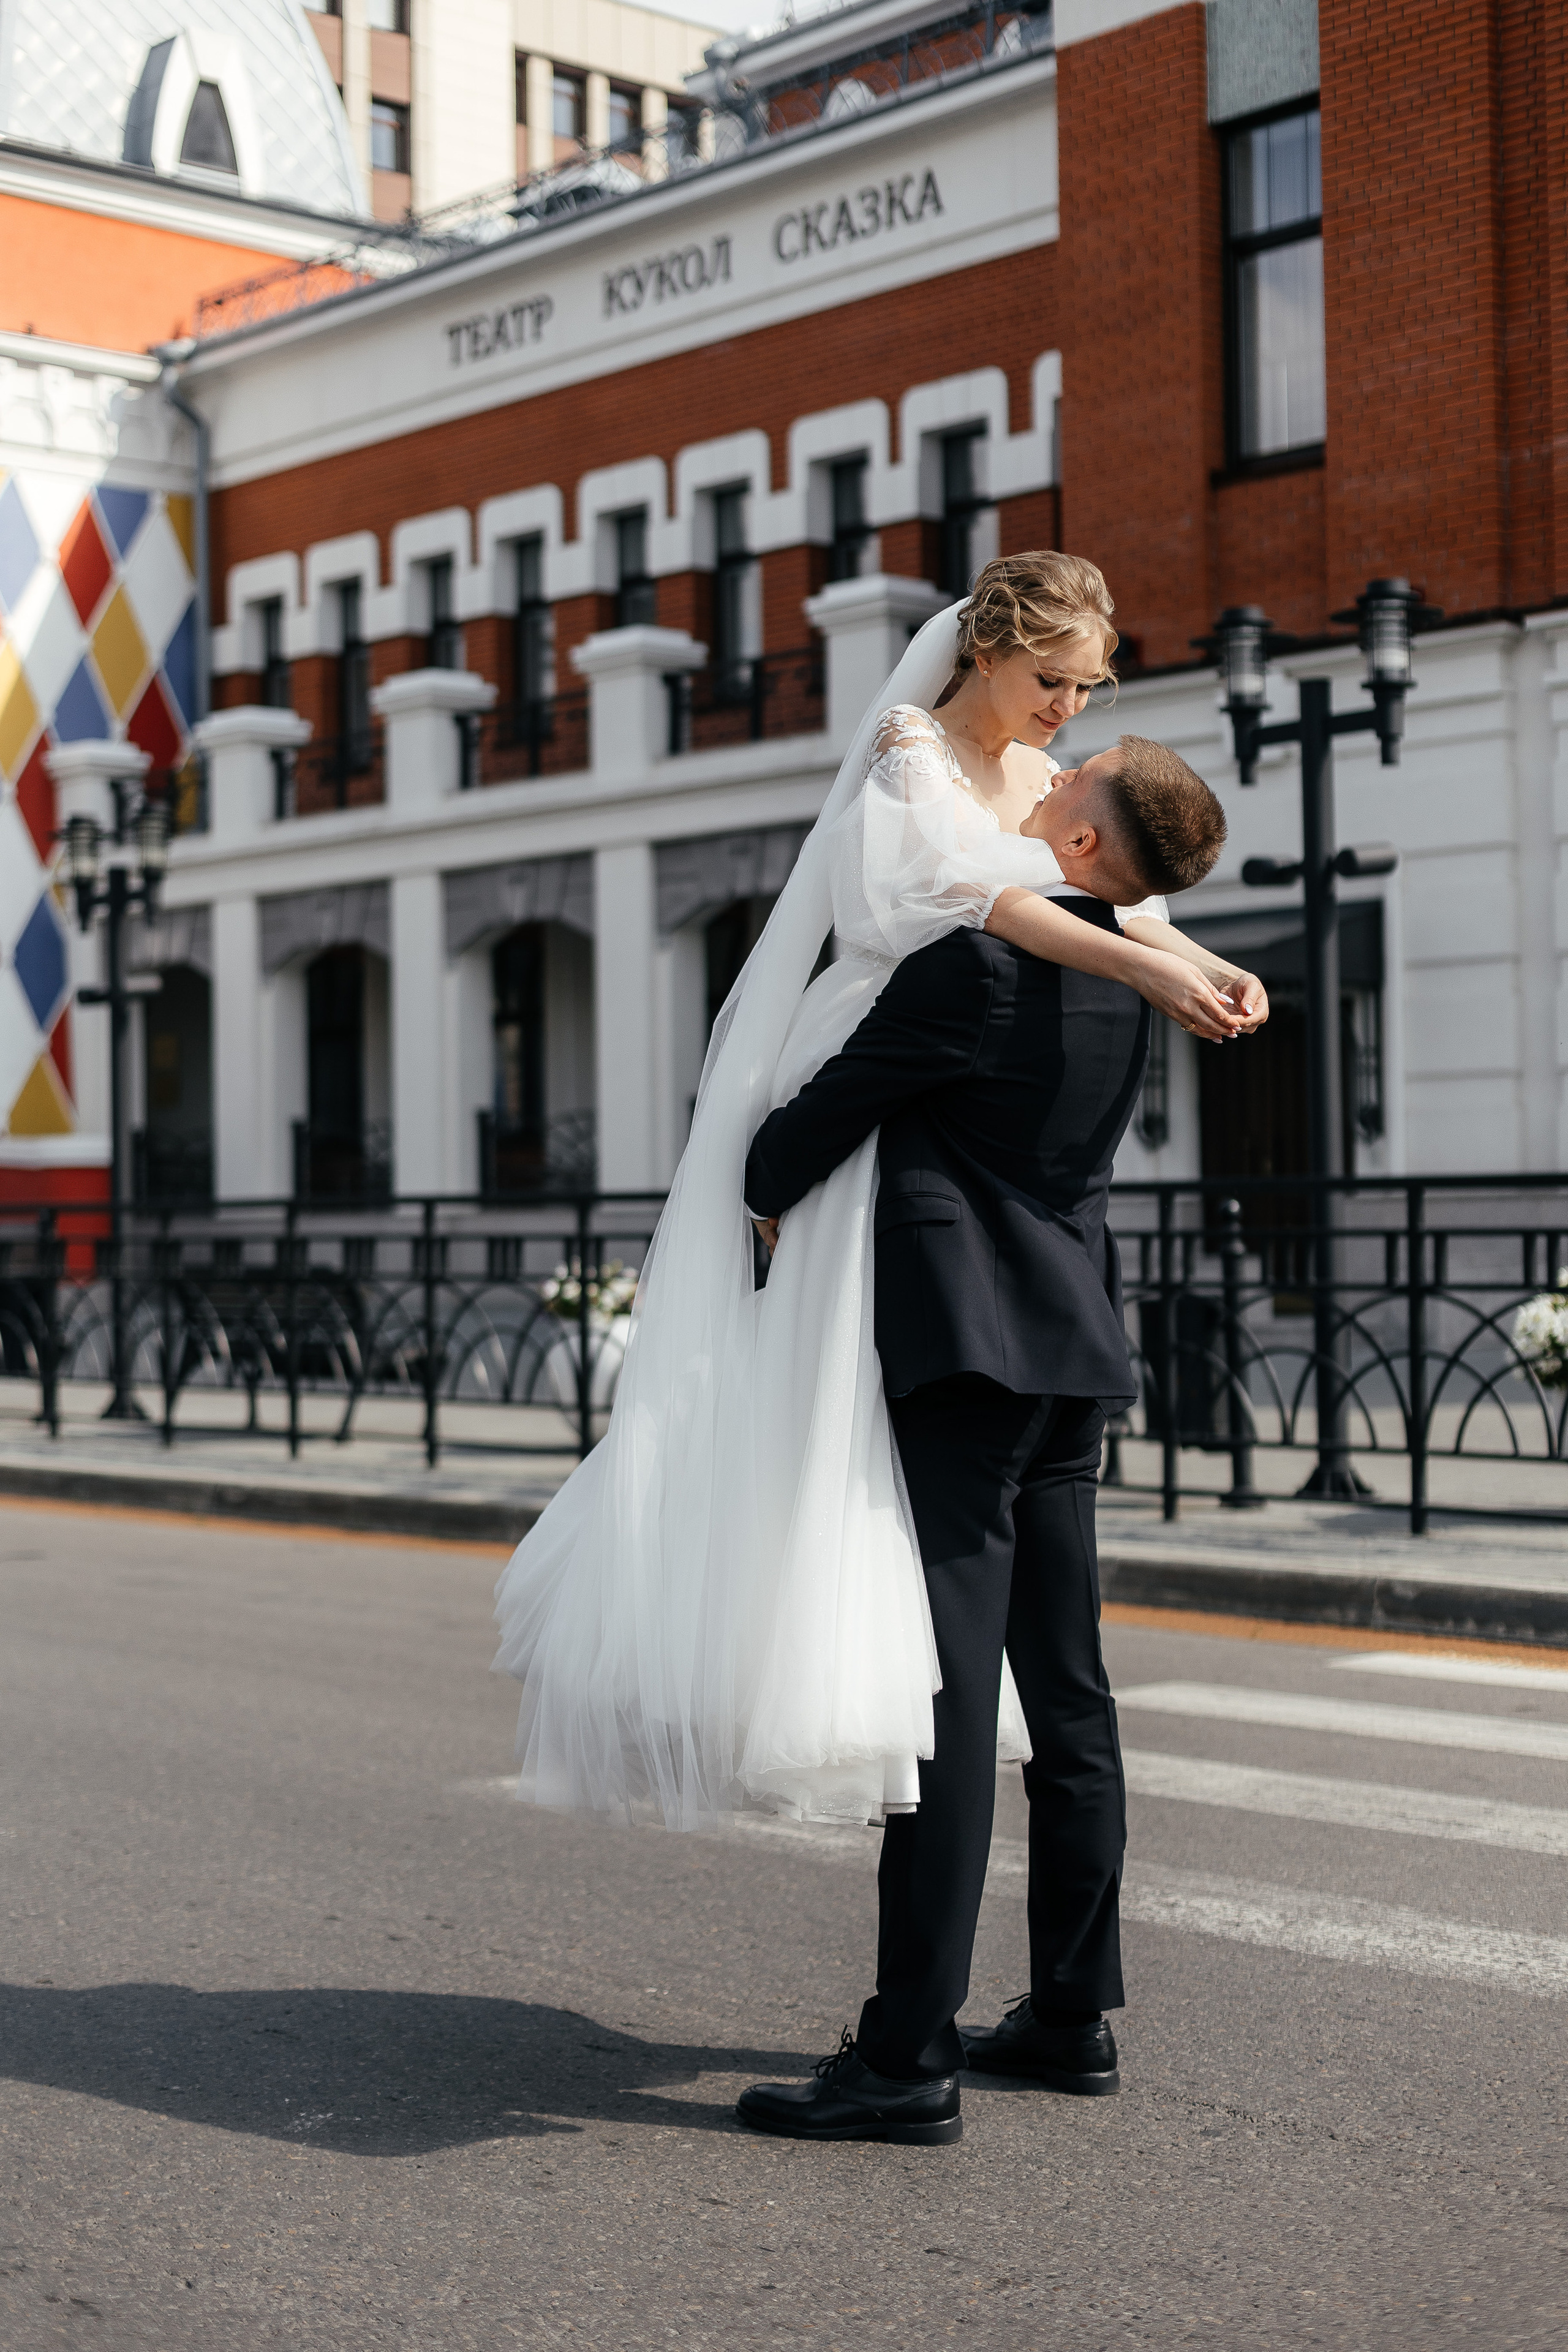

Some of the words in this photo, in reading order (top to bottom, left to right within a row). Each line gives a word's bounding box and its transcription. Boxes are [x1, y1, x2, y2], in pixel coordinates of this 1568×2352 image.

[446, 295, 554, 365] ТЕАТР
[601, 237, 733, 317] КУКОЛ
[773, 167, 944, 263] СКАЗКА
